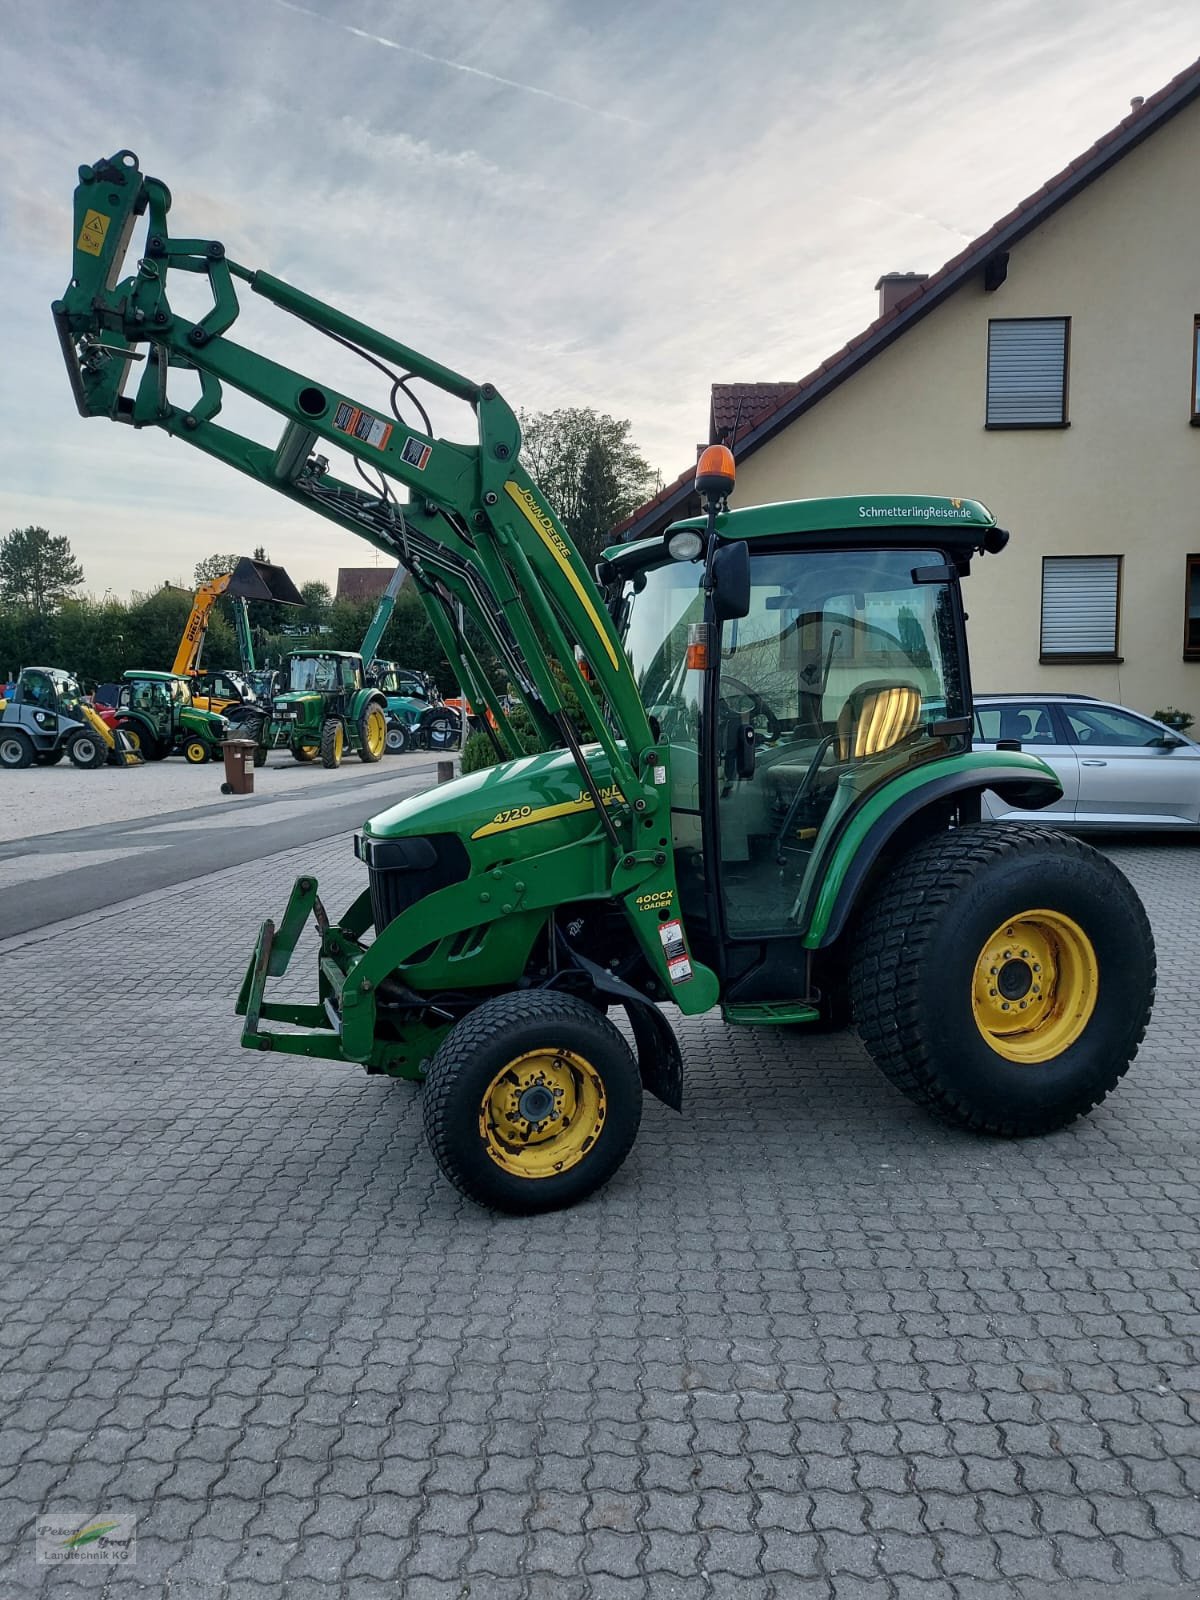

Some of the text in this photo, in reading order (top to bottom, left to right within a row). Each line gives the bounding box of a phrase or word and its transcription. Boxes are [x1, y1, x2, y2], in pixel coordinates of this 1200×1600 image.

[858, 506, 972, 520] SchmetterlingReisen.de
[518, 487, 572, 559] JOHN DEERE
[493, 805, 532, 824] 4720
[636, 889, 673, 904] 400CX
[639, 899, 671, 912] LOADER
